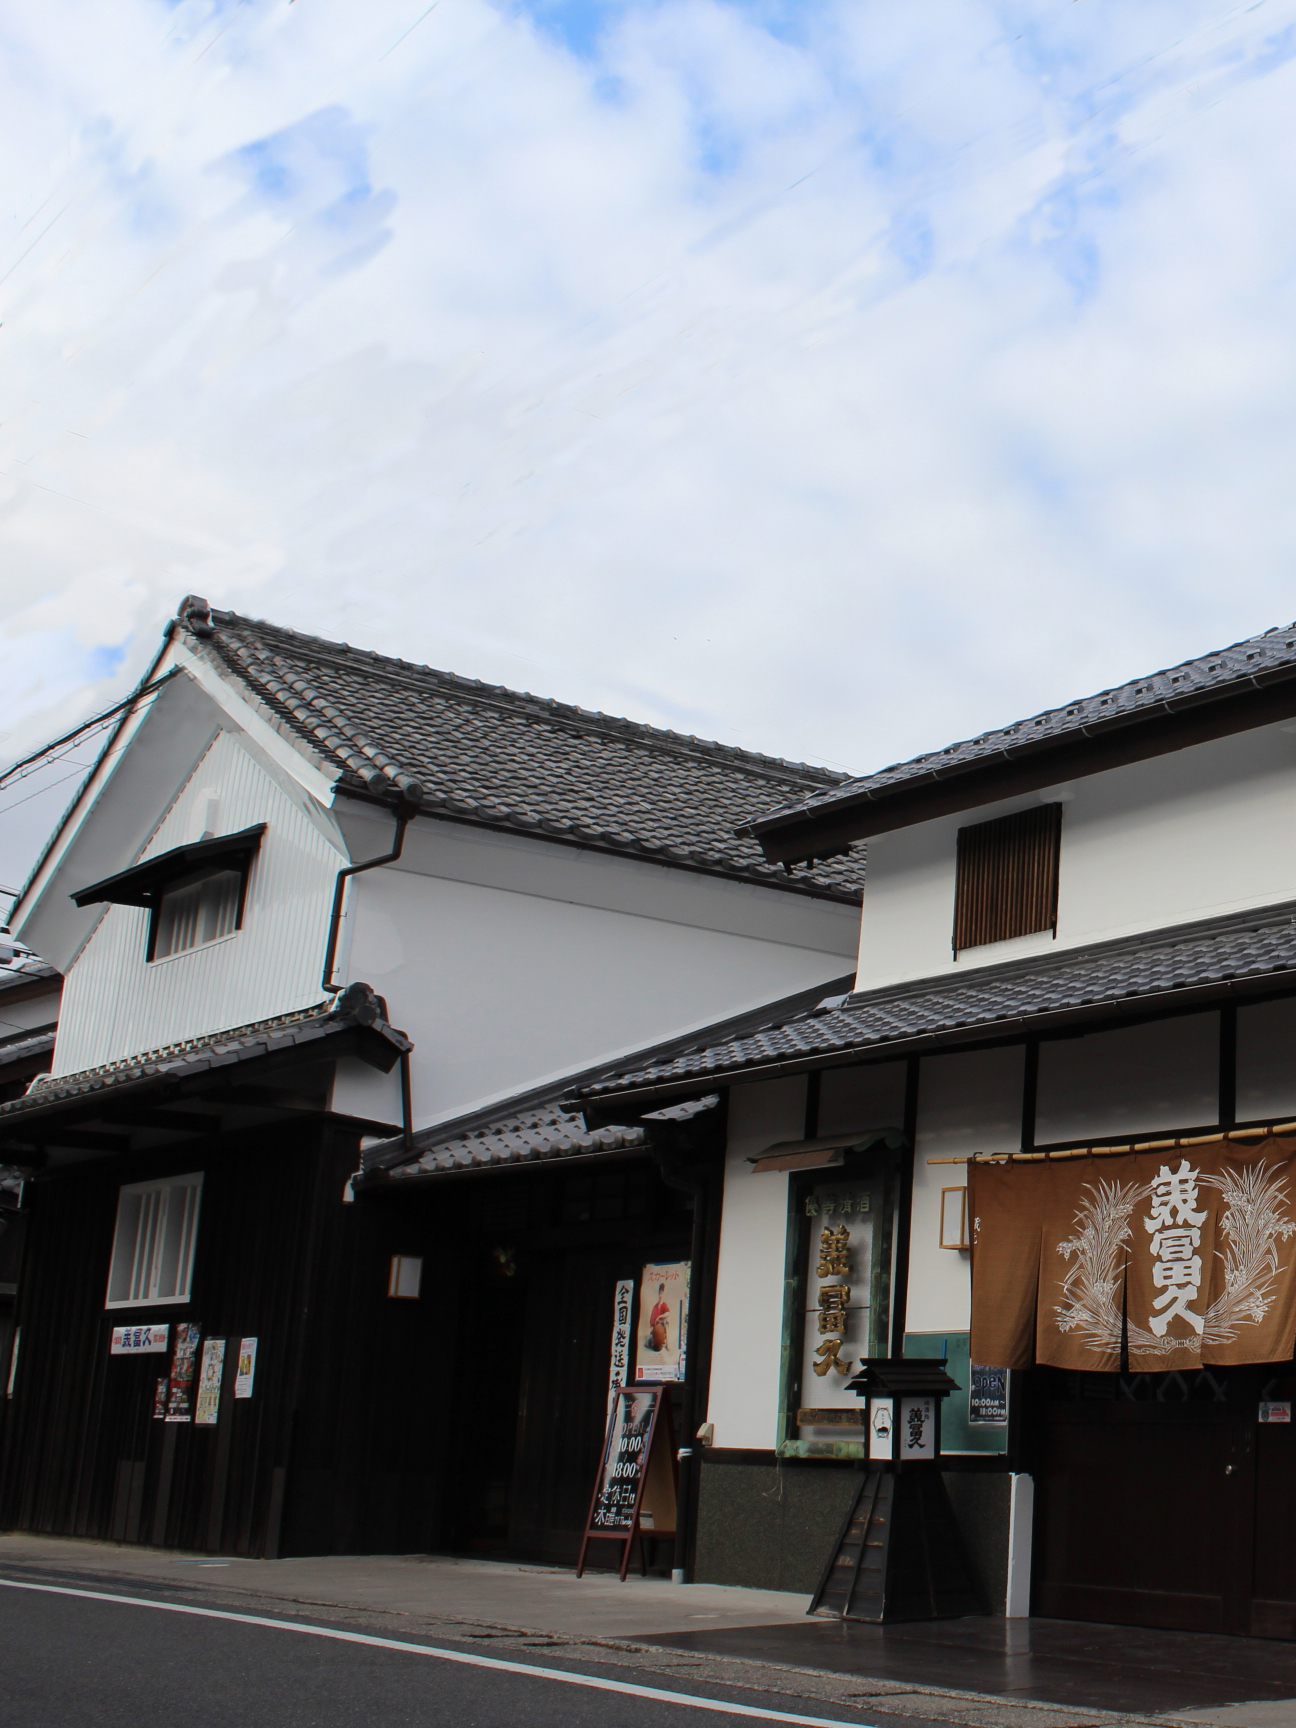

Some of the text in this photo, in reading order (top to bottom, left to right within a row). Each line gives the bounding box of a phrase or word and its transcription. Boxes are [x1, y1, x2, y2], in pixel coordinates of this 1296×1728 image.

[647, 1270, 681, 1282] スカーレット
[618, 1436, 641, 1452] 10:00
[612, 1462, 636, 1478] 18:00
